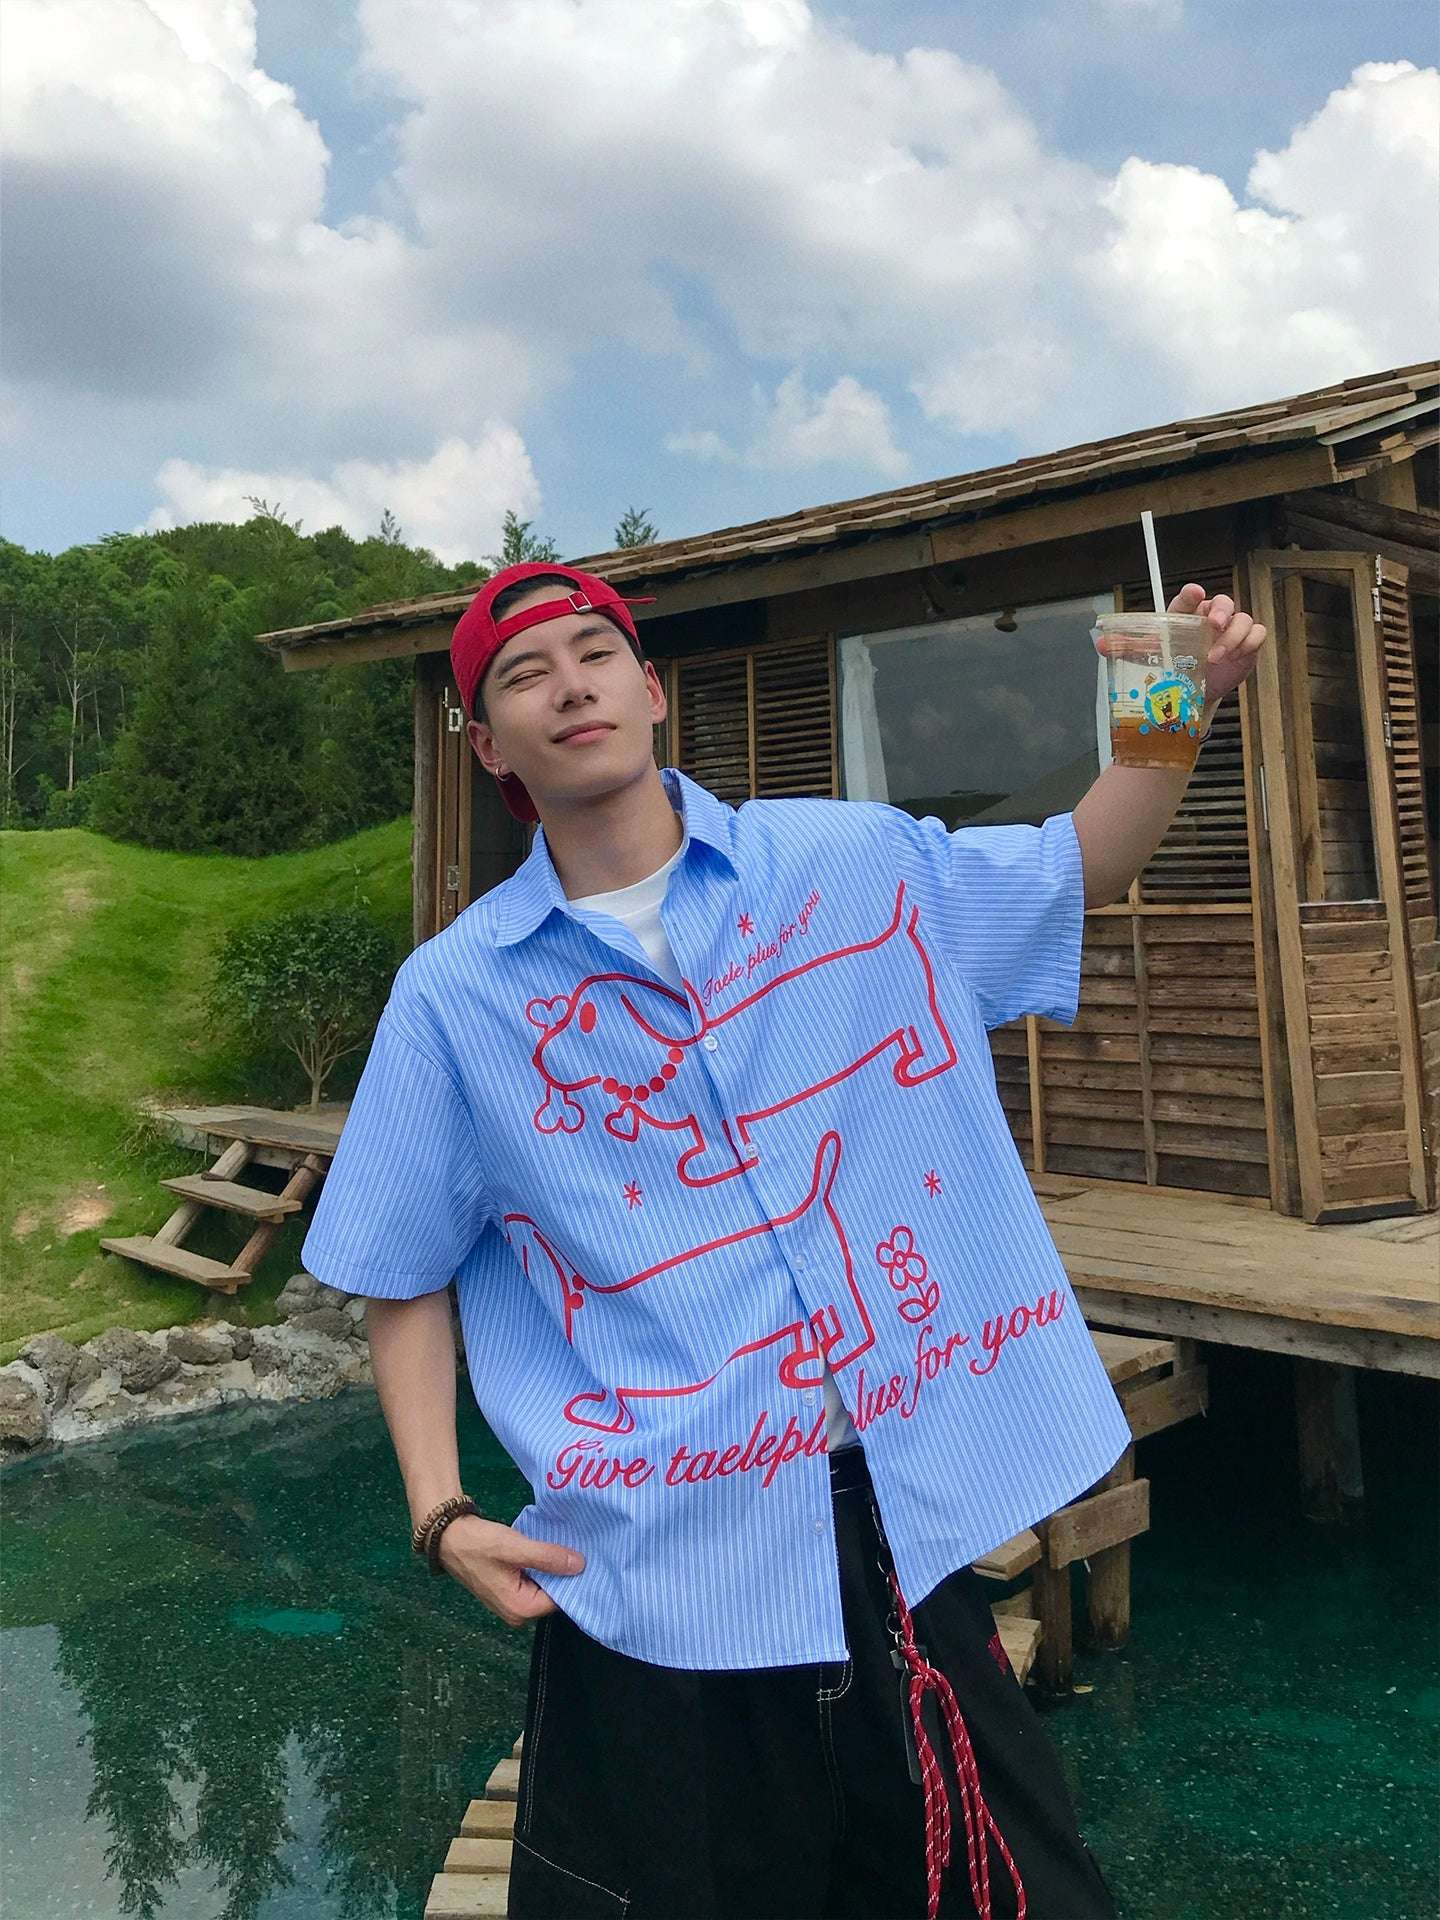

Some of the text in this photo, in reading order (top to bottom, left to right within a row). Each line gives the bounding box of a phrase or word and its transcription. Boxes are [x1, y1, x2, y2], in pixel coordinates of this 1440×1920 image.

[747, 942, 778, 980] plus
[776, 922, 797, 959] for
[797, 888, 821, 936] you
[546, 1438, 656, 1490] Give
[899, 1324, 970, 1420] for
[969, 1289, 1066, 1376] you
